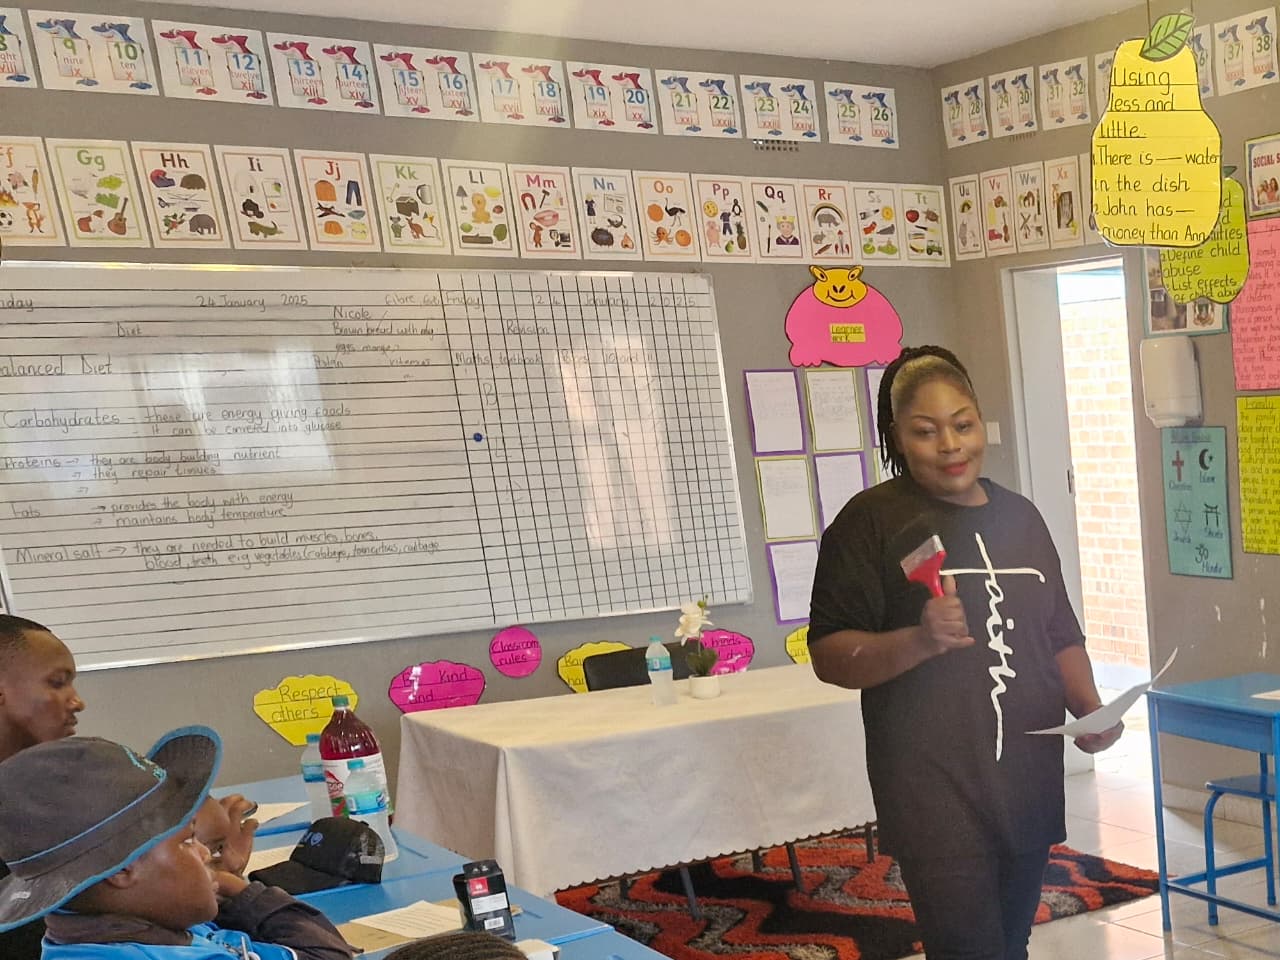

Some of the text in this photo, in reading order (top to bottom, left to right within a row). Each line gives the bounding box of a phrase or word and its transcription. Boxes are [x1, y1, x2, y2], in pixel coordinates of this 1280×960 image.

[64, 39, 76, 54] 9
[114, 43, 138, 60] 10
[1227, 44, 1241, 60] 37
[1256, 36, 1271, 53] 38
[180, 50, 202, 66] 11
[232, 54, 255, 71] 12
[293, 61, 315, 77] 13
[342, 64, 362, 80] 14
[400, 72, 419, 87] 15
[443, 74, 463, 90] 16
[1113, 67, 1171, 95] Using
[496, 80, 513, 95] 17
[537, 83, 556, 98] 18
[588, 86, 606, 101] 19
[1050, 86, 1061, 99] 31
[1072, 80, 1084, 96] 32
[626, 90, 645, 104] 20
[675, 94, 692, 108] 21
[712, 97, 730, 110] 22
[999, 94, 1010, 109] 29
[1019, 90, 1030, 105] 30
[1110, 92, 1175, 112] less and
[759, 98, 775, 112] 23
[792, 101, 810, 114] 24
[841, 105, 856, 118] 25
[951, 105, 961, 120] 27
[971, 101, 981, 116] 28
[873, 109, 889, 121] 26
[77, 150, 105, 171] Gg
[160, 153, 190, 169] Hh
[247, 157, 263, 172] Ii
[1139, 151, 1154, 166] is
[1253, 154, 1275, 168] SOCIAL
[325, 161, 341, 181] Jj
[396, 166, 418, 180] Kk
[469, 170, 484, 184] Ll
[1057, 167, 1069, 180] Xx
[526, 175, 557, 189] Mm
[593, 177, 615, 191] Nn
[653, 180, 674, 194] Oo
[989, 179, 1000, 190] Vv
[1020, 174, 1037, 185] Ww
[1094, 172, 1190, 193] in the dish
[712, 183, 730, 200] Pp
[764, 186, 785, 203] Qq
[818, 189, 832, 200] Rr
[868, 190, 882, 204] Ss
[915, 192, 928, 204] Tt
[959, 186, 970, 196] Uu
[1102, 196, 1173, 217] John has
[1102, 226, 1145, 244] money
[1150, 222, 1178, 241] than
[1210, 241, 1241, 257] child
[1163, 263, 1201, 278] abuse
[1197, 274, 1237, 290] effects
[199, 294, 309, 312] 24 January 2025
[333, 306, 372, 320] Nicole
[0, 353, 112, 376] alanced Diet
[2, 410, 121, 433] Carbohydrates
[222, 408, 263, 425] energy
[270, 408, 307, 423] giving
[314, 403, 351, 417] foods
[172, 427, 193, 435] can
[4, 458, 61, 470] Proteins
[90, 454, 117, 470] they
[145, 451, 171, 467] body
[233, 448, 280, 461] nutrient
[93, 467, 167, 484] they repair
[163, 496, 180, 509] the
[187, 494, 216, 511] body
[223, 493, 250, 507] with
[259, 492, 294, 508] energy
[115, 506, 287, 528] maintains body temperature
[134, 540, 160, 556] they
[192, 536, 233, 551] needed
[240, 534, 256, 548] to
[260, 530, 289, 544] build
[16, 547, 69, 563] Mineral
[490, 639, 540, 654] Classroom
[498, 653, 527, 666] rules
[439, 669, 468, 681] Kind
[279, 684, 341, 705] Respect
[271, 705, 320, 722] others
